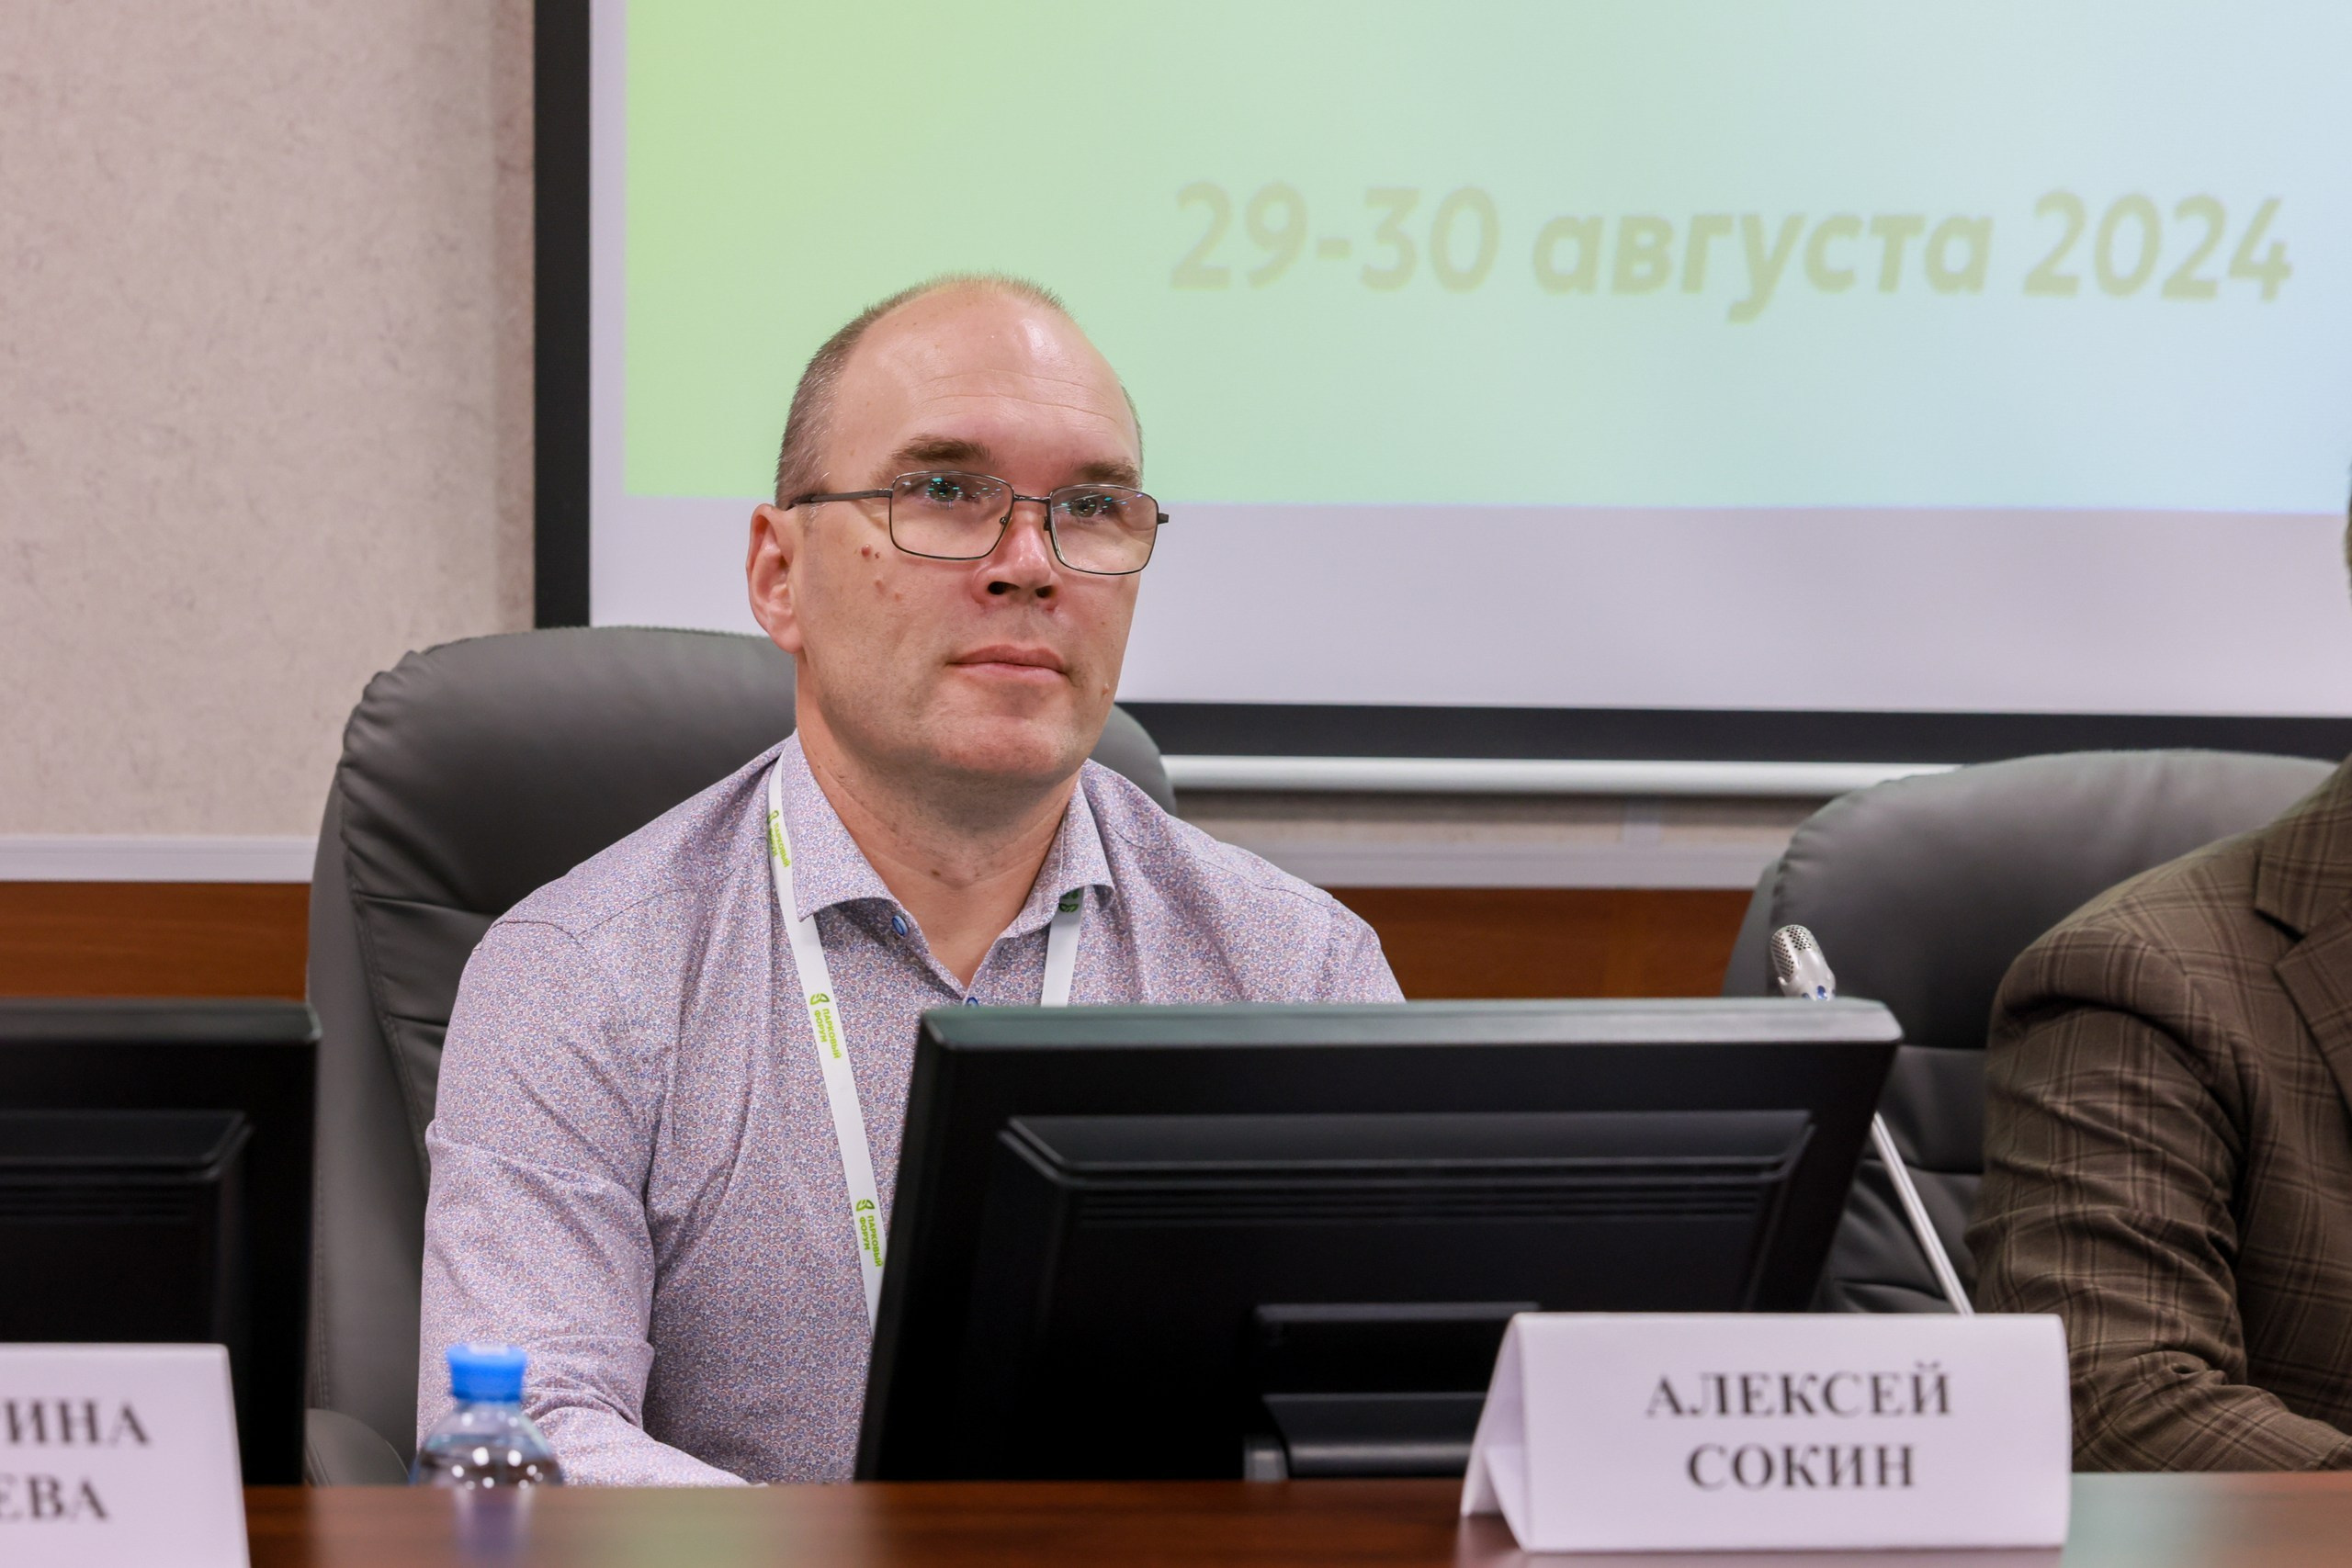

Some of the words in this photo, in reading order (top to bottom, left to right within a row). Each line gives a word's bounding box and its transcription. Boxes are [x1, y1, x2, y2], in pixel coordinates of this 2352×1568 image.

[1170, 181, 1502, 295] 29-30
[1532, 212, 1995, 326] августа
[2021, 188, 2295, 305] 2024
[814, 1010, 828, 1043] ФОРУМ
[822, 1008, 842, 1058] ПАРКОВЫЙ
[859, 1216, 871, 1250] ФОРУМ
[867, 1214, 883, 1268] ПАРКОВЫЙ
[1646, 1362, 1951, 1417] АЛЕКСЕЙ
[2, 1398, 151, 1446] ИНА
[1685, 1443, 1915, 1490] СОКИН
